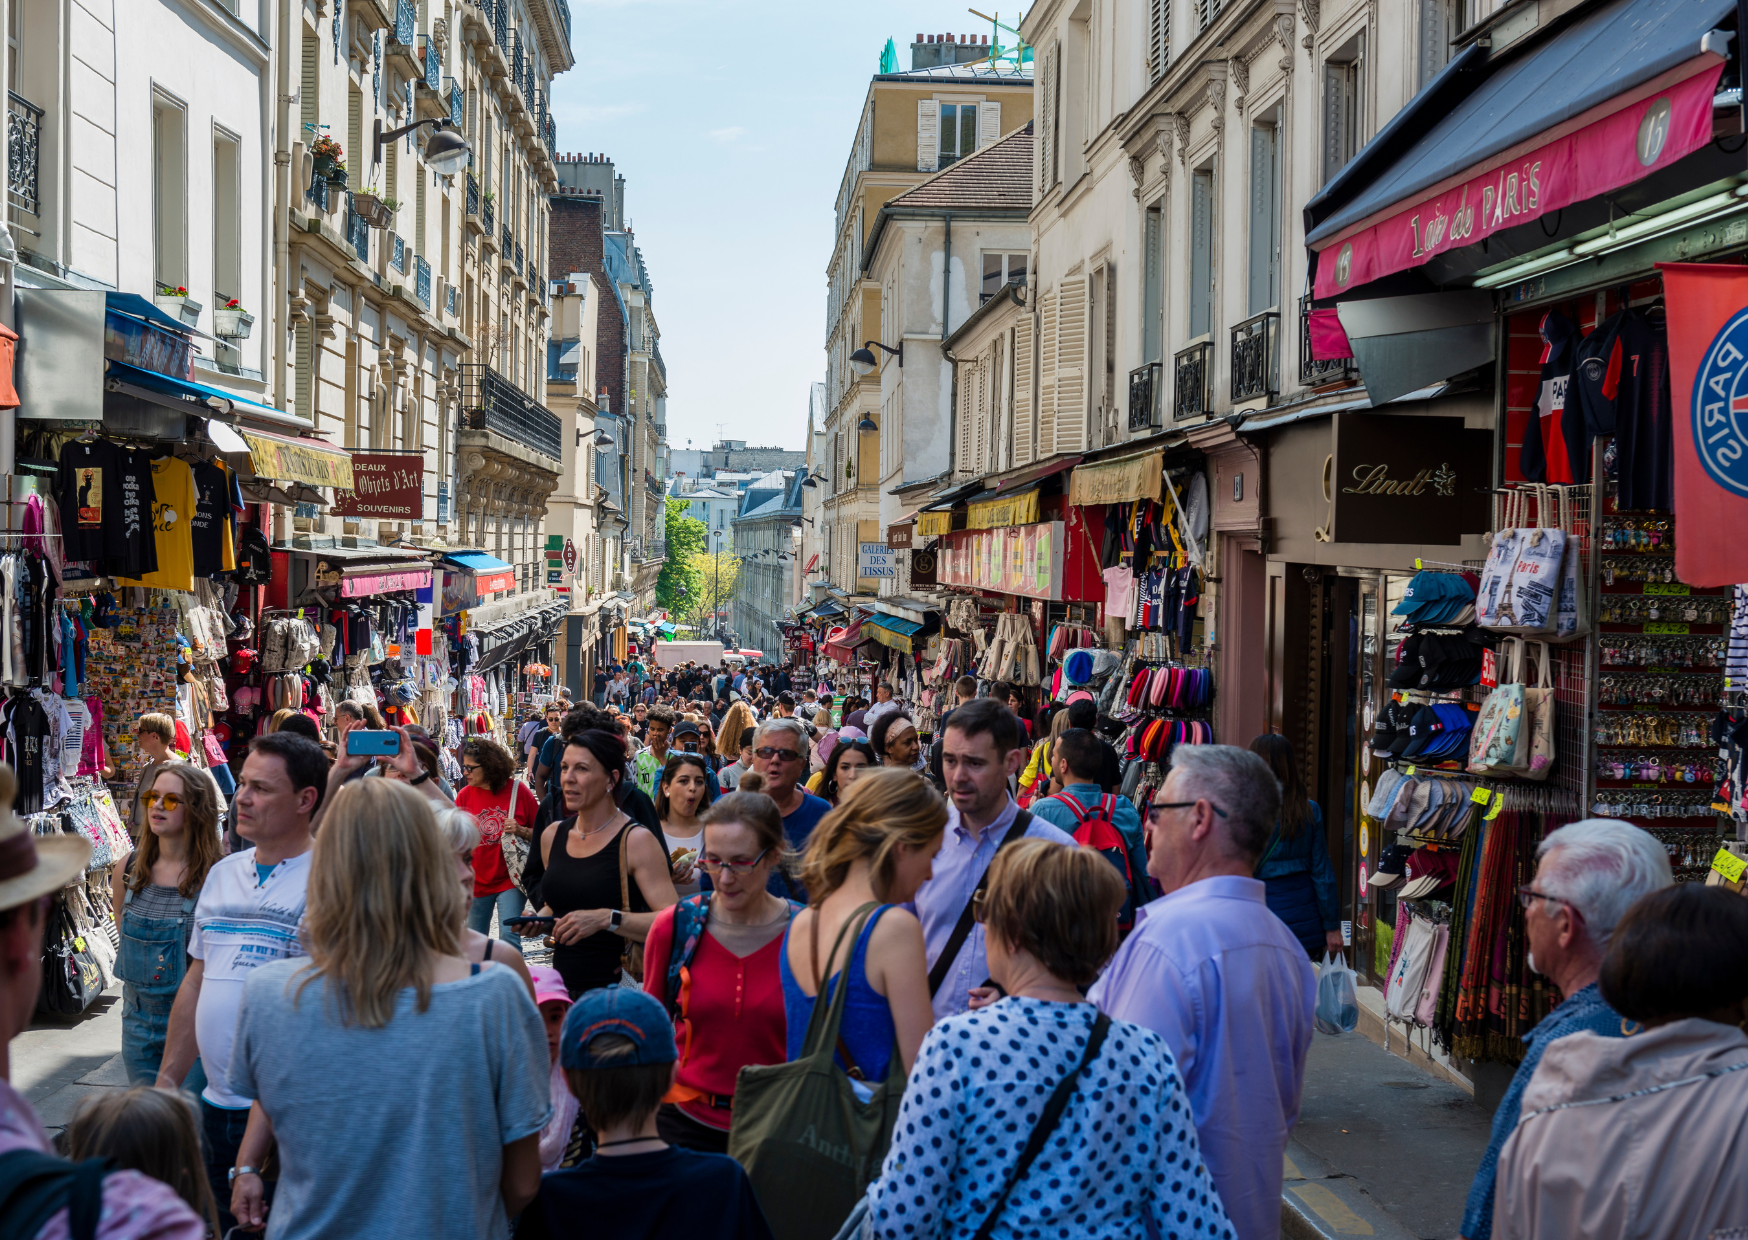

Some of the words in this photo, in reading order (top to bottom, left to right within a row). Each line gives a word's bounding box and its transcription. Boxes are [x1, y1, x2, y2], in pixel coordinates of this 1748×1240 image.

[1644, 109, 1668, 158] 15
[1411, 214, 1424, 258] 1
[1424, 202, 1449, 252] air
[1449, 184, 1475, 240] de
[1339, 250, 1351, 282] 15
[1630, 354, 1640, 377] 7
[358, 475, 391, 497] Objets
[393, 468, 419, 490] d'Art
[1342, 463, 1434, 496] Lindt
[356, 504, 411, 514] SOUVENIRS
[249, 543, 264, 553] FRANCE
[862, 544, 895, 555] GALERIES
[870, 556, 887, 565] DES
[1516, 560, 1540, 574] Paris
[862, 567, 894, 576] TISSUS
[642, 772, 650, 784] 10
